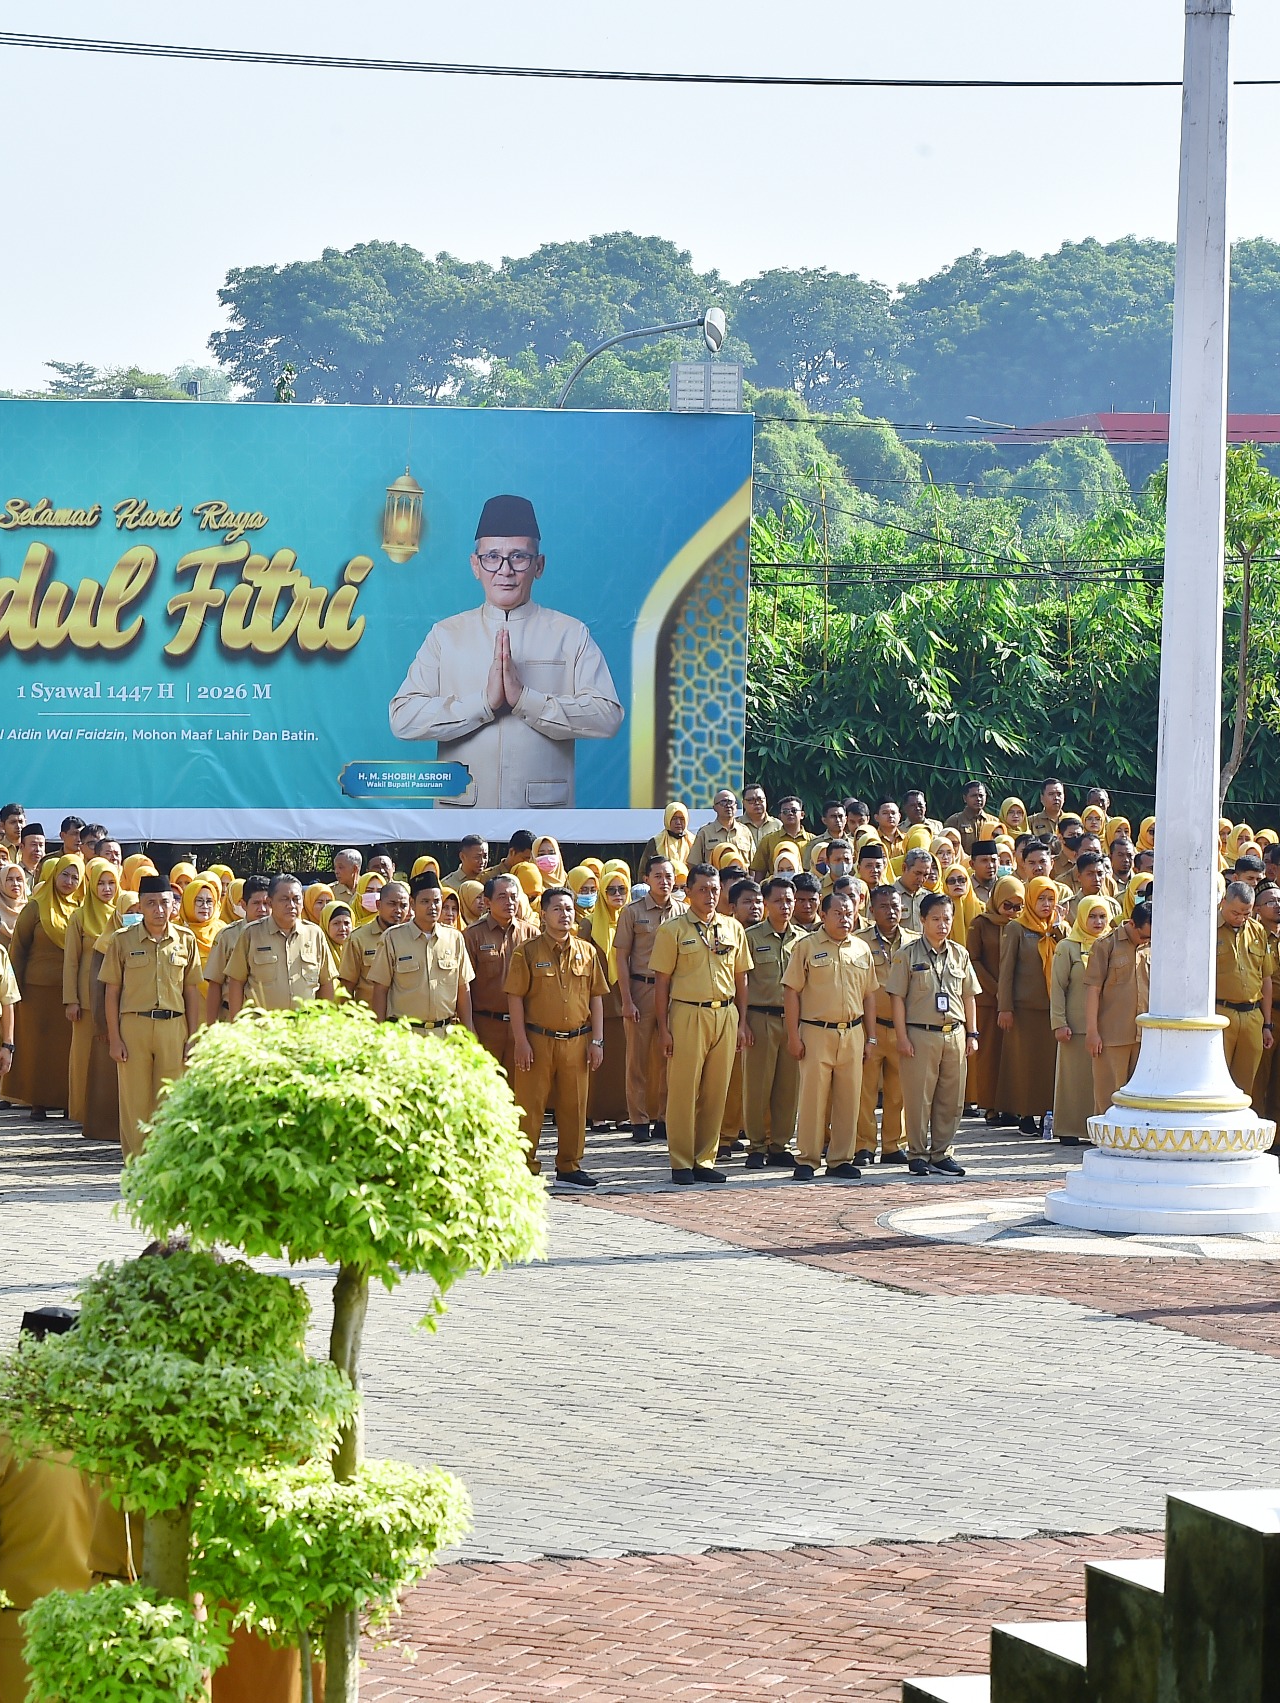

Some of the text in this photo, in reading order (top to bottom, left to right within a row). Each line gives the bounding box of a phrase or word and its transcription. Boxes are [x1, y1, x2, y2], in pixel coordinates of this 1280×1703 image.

[113, 498, 183, 530] Hari
[193, 500, 269, 544] Raya
[163, 540, 374, 655] Fitri
[16, 686, 26, 699] 1
[30, 682, 102, 702] Syawal
[107, 685, 153, 702] 1447
[156, 683, 175, 699] H
[197, 683, 248, 699] 2026
[252, 683, 272, 700] M
[6, 728, 42, 740] Aidin
[46, 728, 73, 740] Wal
[75, 728, 128, 742] Faidzin,
[132, 729, 177, 740] Mohon
[180, 729, 214, 741] Maaf
[216, 729, 248, 741] Lahir
[252, 730, 278, 741] Dan
[281, 730, 319, 741] Batin.
[382, 772, 416, 780] SHOBIH
